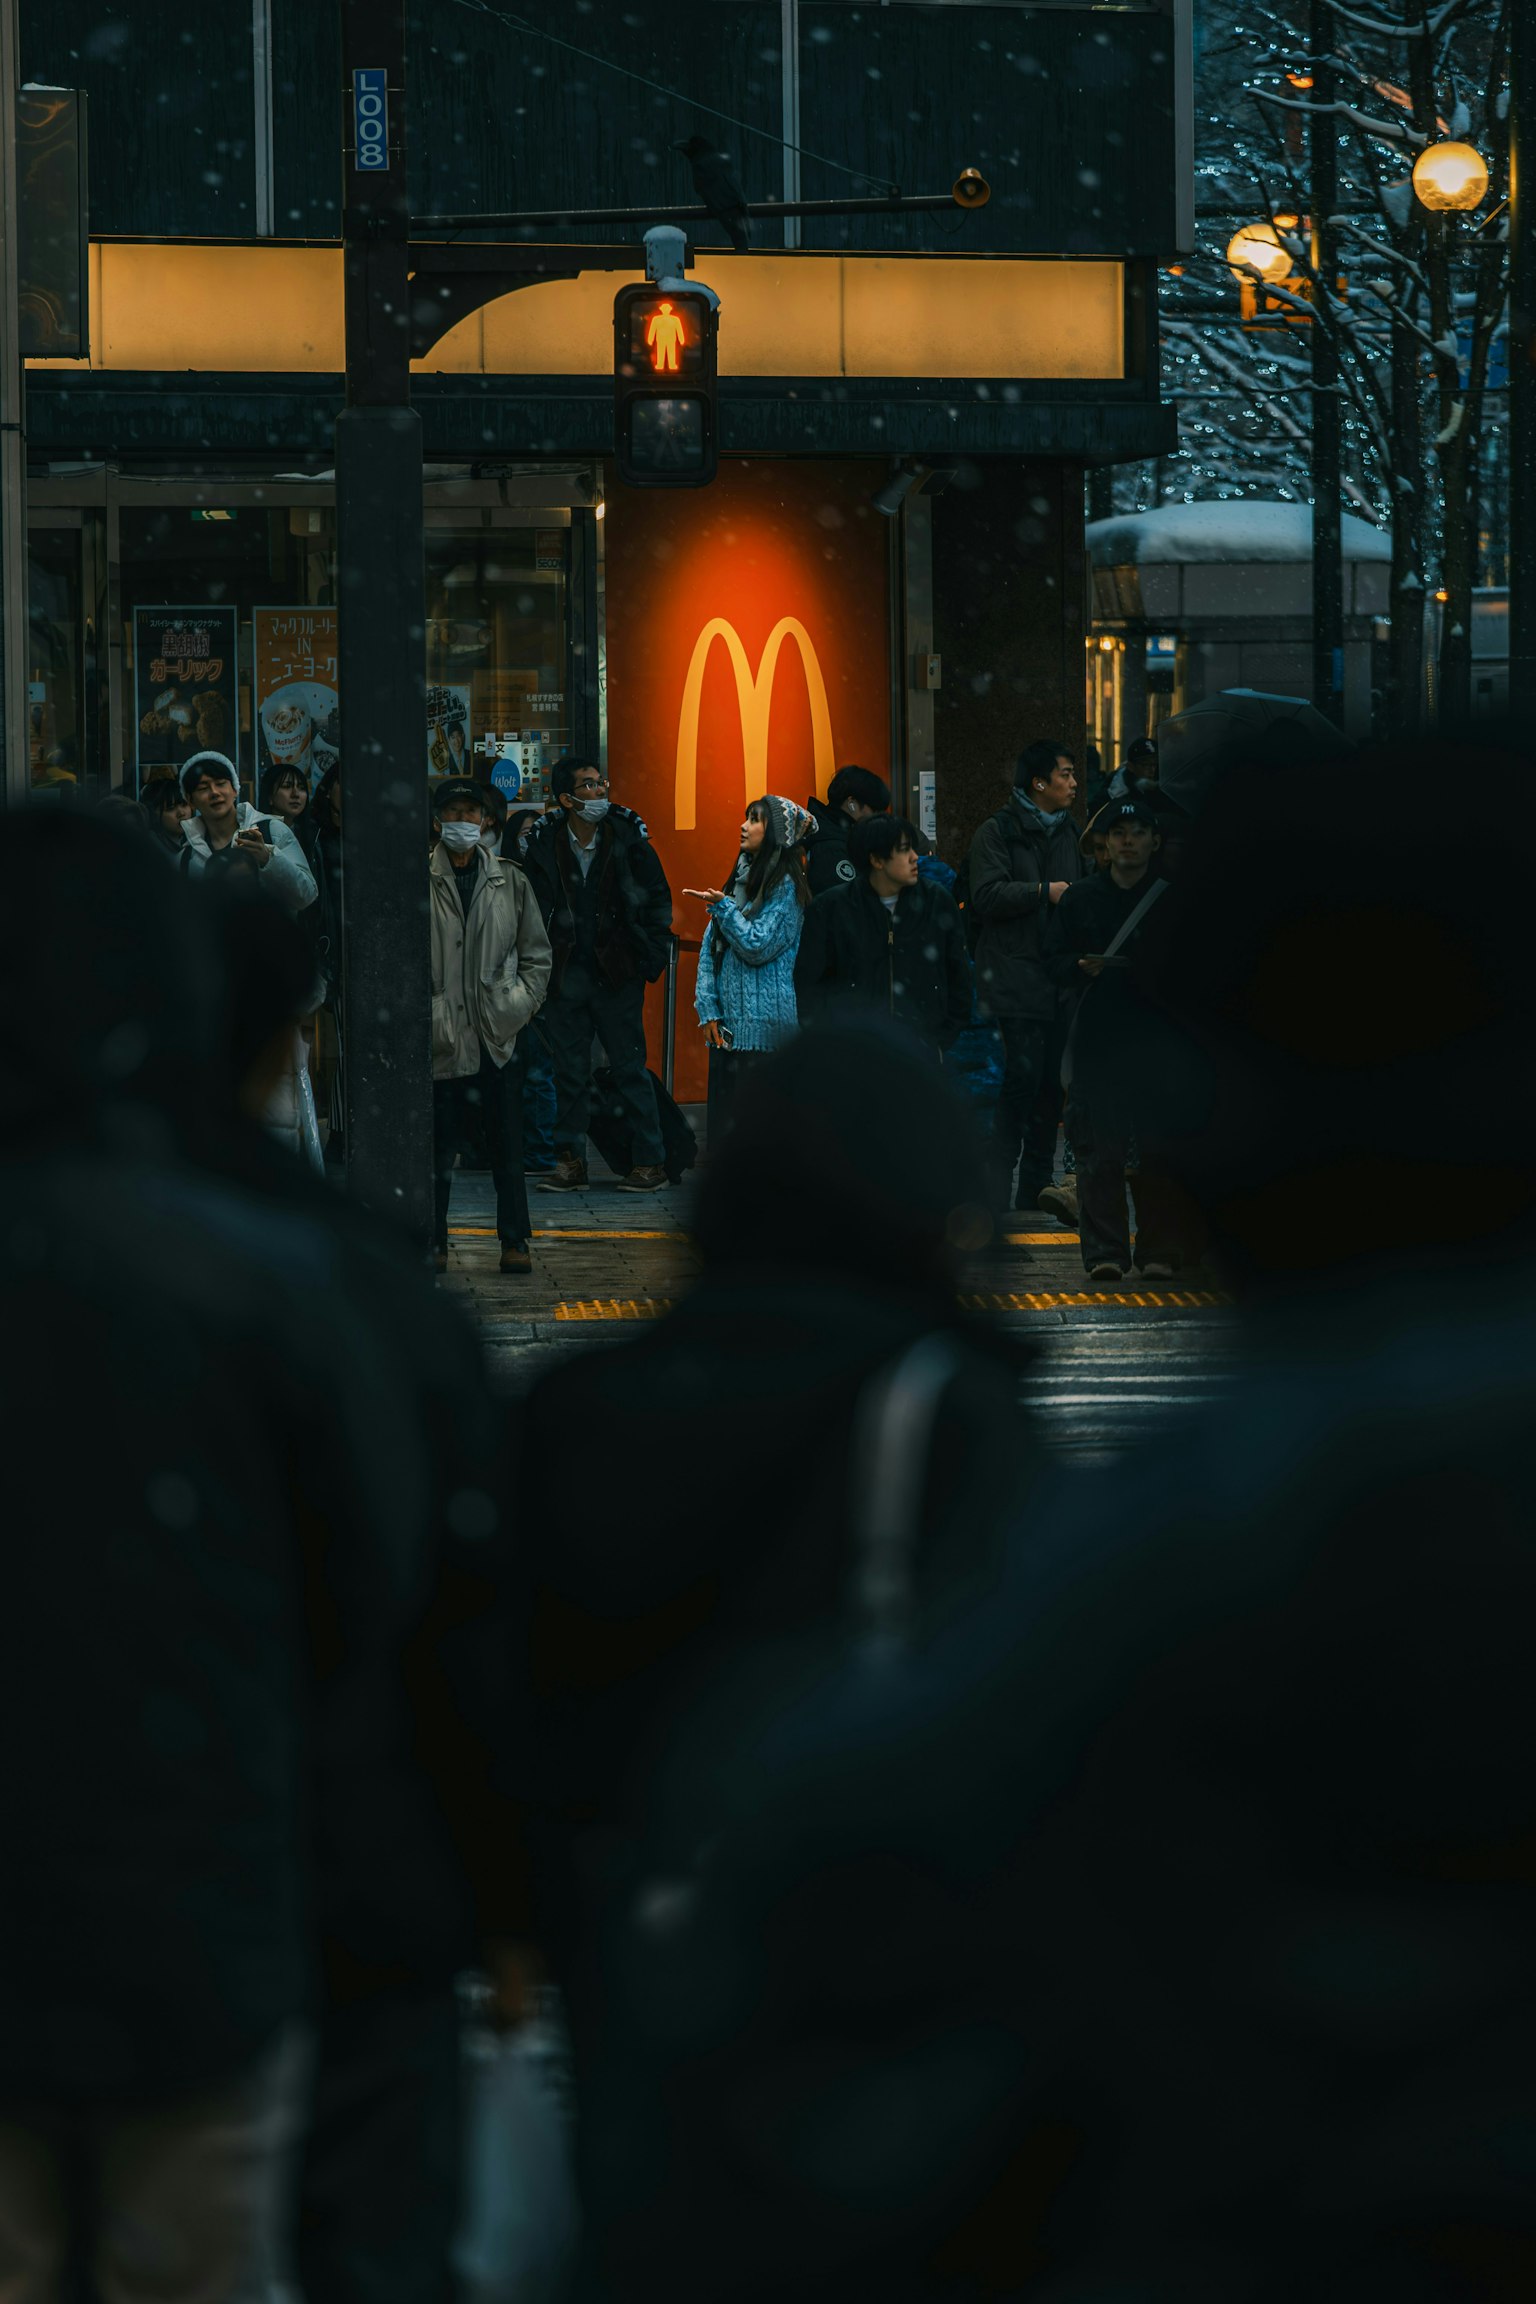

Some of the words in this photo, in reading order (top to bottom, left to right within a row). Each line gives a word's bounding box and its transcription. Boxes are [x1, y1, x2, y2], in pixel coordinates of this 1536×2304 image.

[297, 637, 312, 655] IN
[150, 659, 223, 682] ガーリック
[495, 775, 517, 788] Wolt
